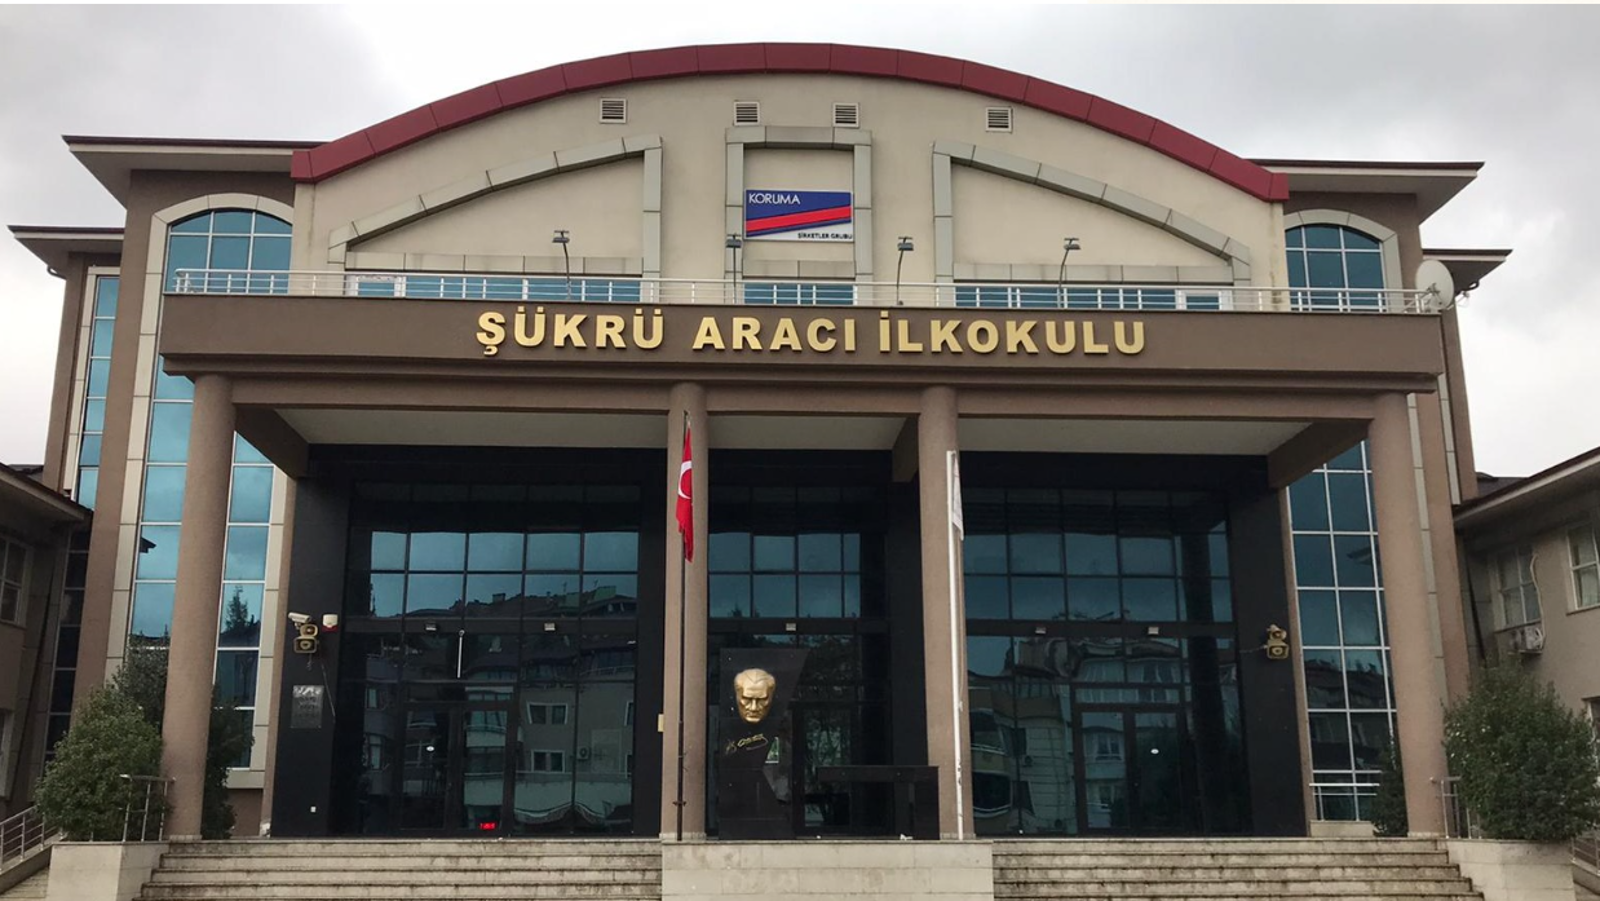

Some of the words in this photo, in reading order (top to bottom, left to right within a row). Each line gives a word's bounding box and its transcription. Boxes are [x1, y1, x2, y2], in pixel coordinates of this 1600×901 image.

[749, 193, 800, 204] KORUMA
[476, 306, 664, 355] ŞÜKRÜ
[692, 317, 855, 351] ARACI
[879, 310, 1145, 354] İLKOKULU
